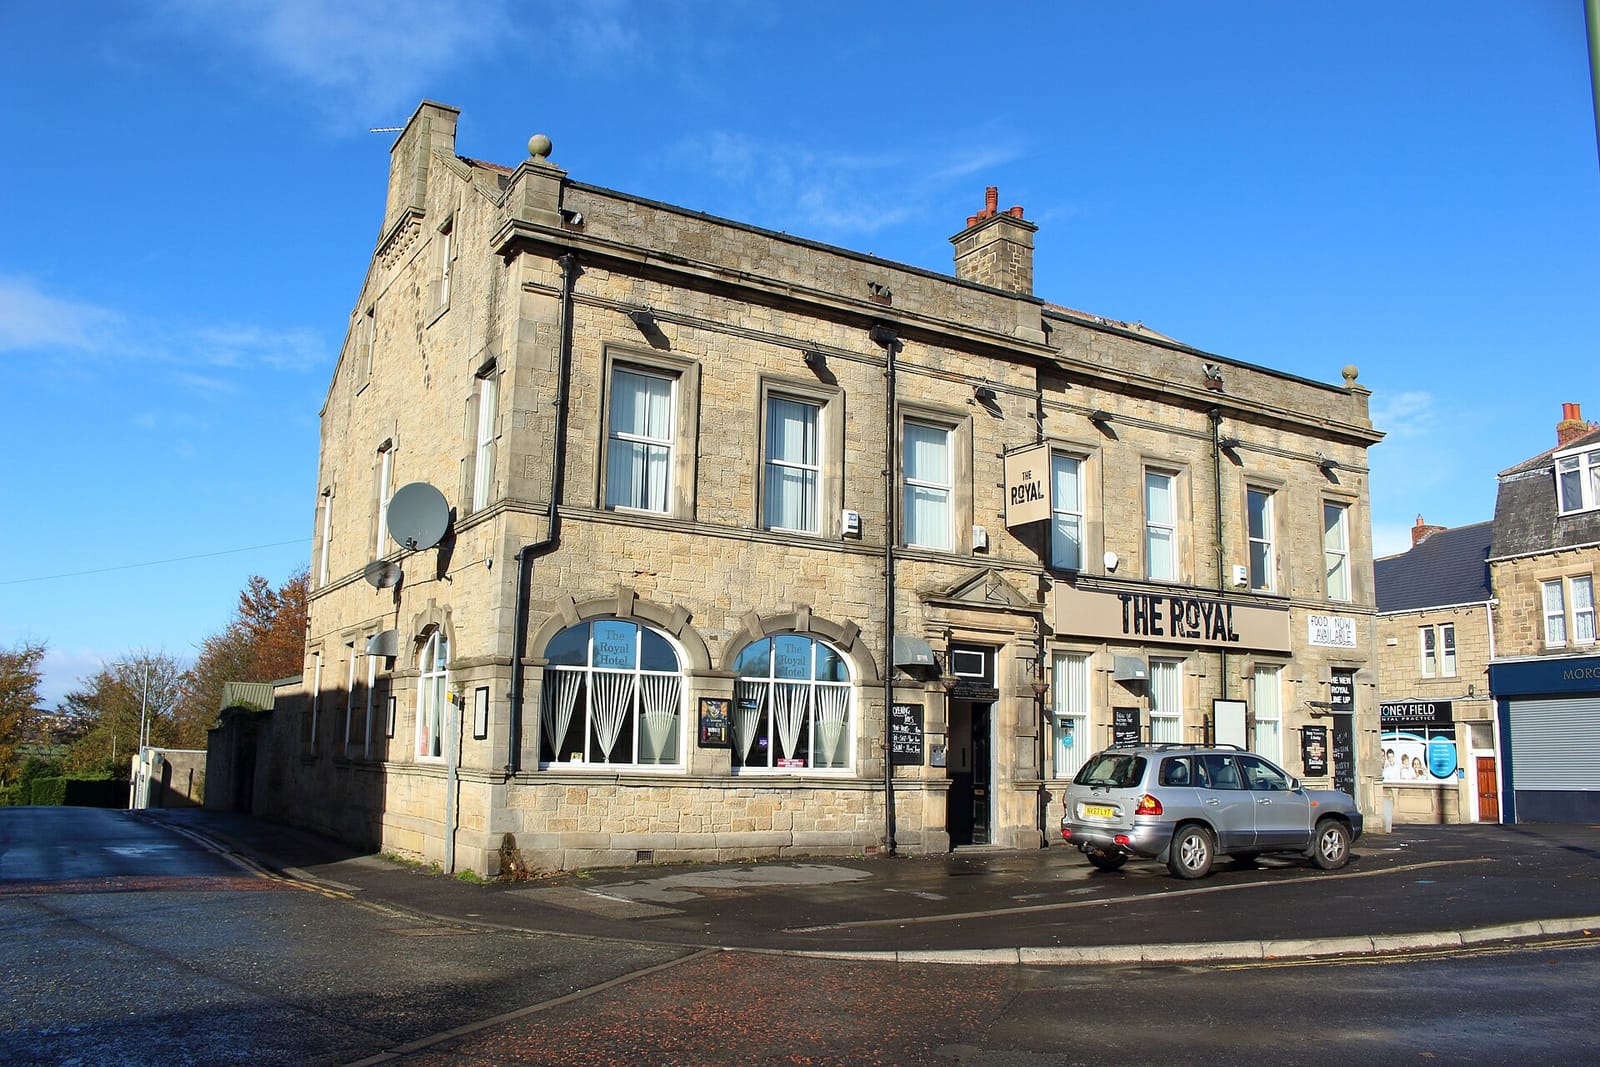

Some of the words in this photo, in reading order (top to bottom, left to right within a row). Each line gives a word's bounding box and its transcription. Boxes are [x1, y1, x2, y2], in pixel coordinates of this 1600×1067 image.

[1022, 470, 1031, 481] THE
[1011, 480, 1044, 505] ROYAL
[1118, 593, 1163, 635] THE
[1170, 598, 1239, 642] ROYAL
[1311, 615, 1328, 627] FOOD
[1335, 617, 1350, 630] NOW
[607, 630, 624, 640] The
[1316, 628, 1351, 643] AVAILABLE
[600, 642, 629, 654] Royal
[785, 643, 801, 653] The
[600, 655, 627, 665] Hotel
[779, 654, 806, 666] Royal
[1331, 686, 1349, 694] ROYAL
[1342, 696, 1351, 704] UP
[1409, 703, 1435, 715] FIELD
